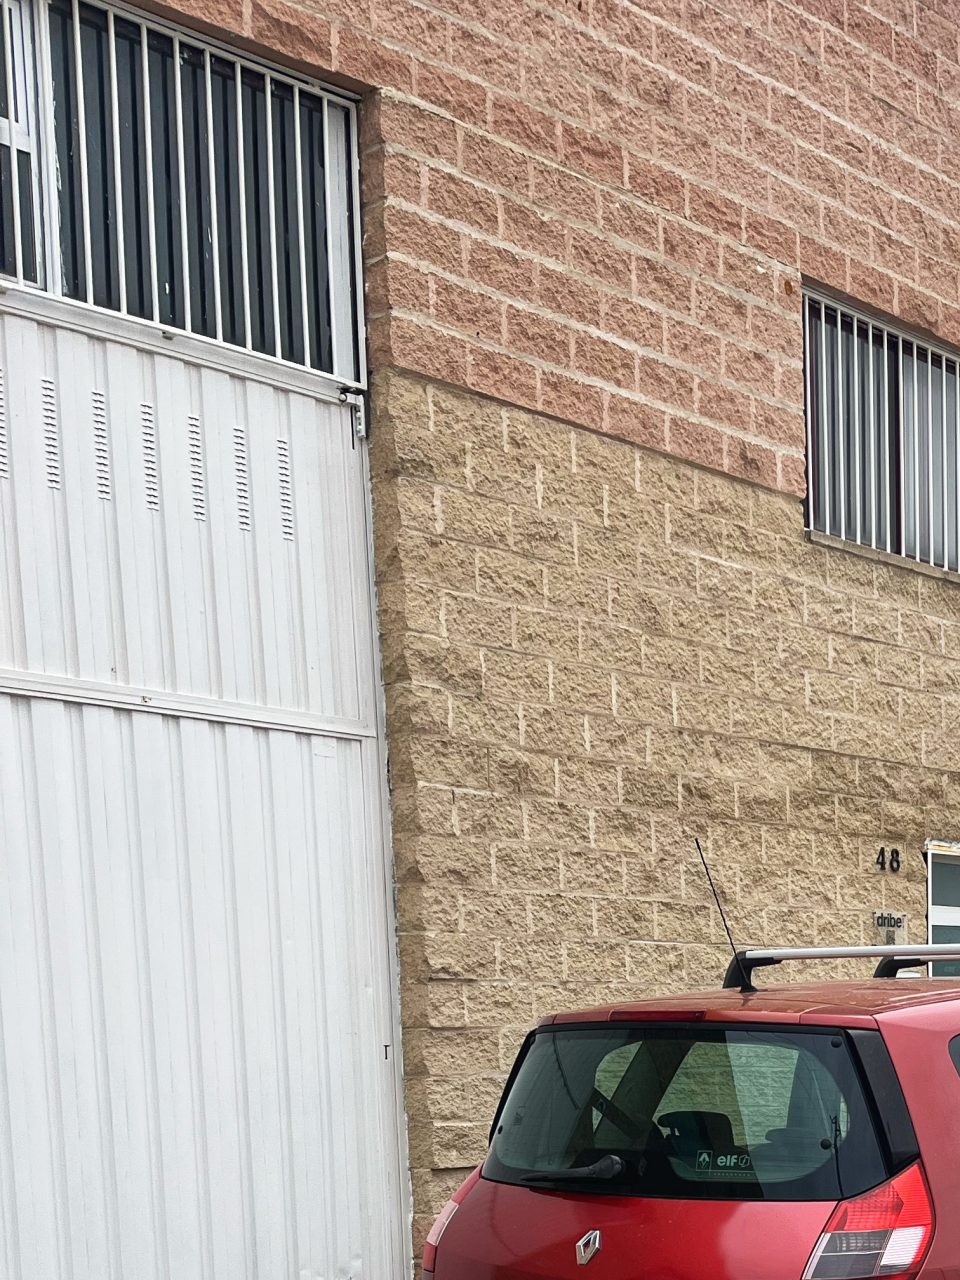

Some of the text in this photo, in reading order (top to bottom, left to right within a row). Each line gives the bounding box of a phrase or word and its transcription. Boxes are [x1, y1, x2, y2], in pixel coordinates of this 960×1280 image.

[876, 847, 900, 872] 48
[876, 913, 902, 928] dribe
[717, 1154, 738, 1167] elf
